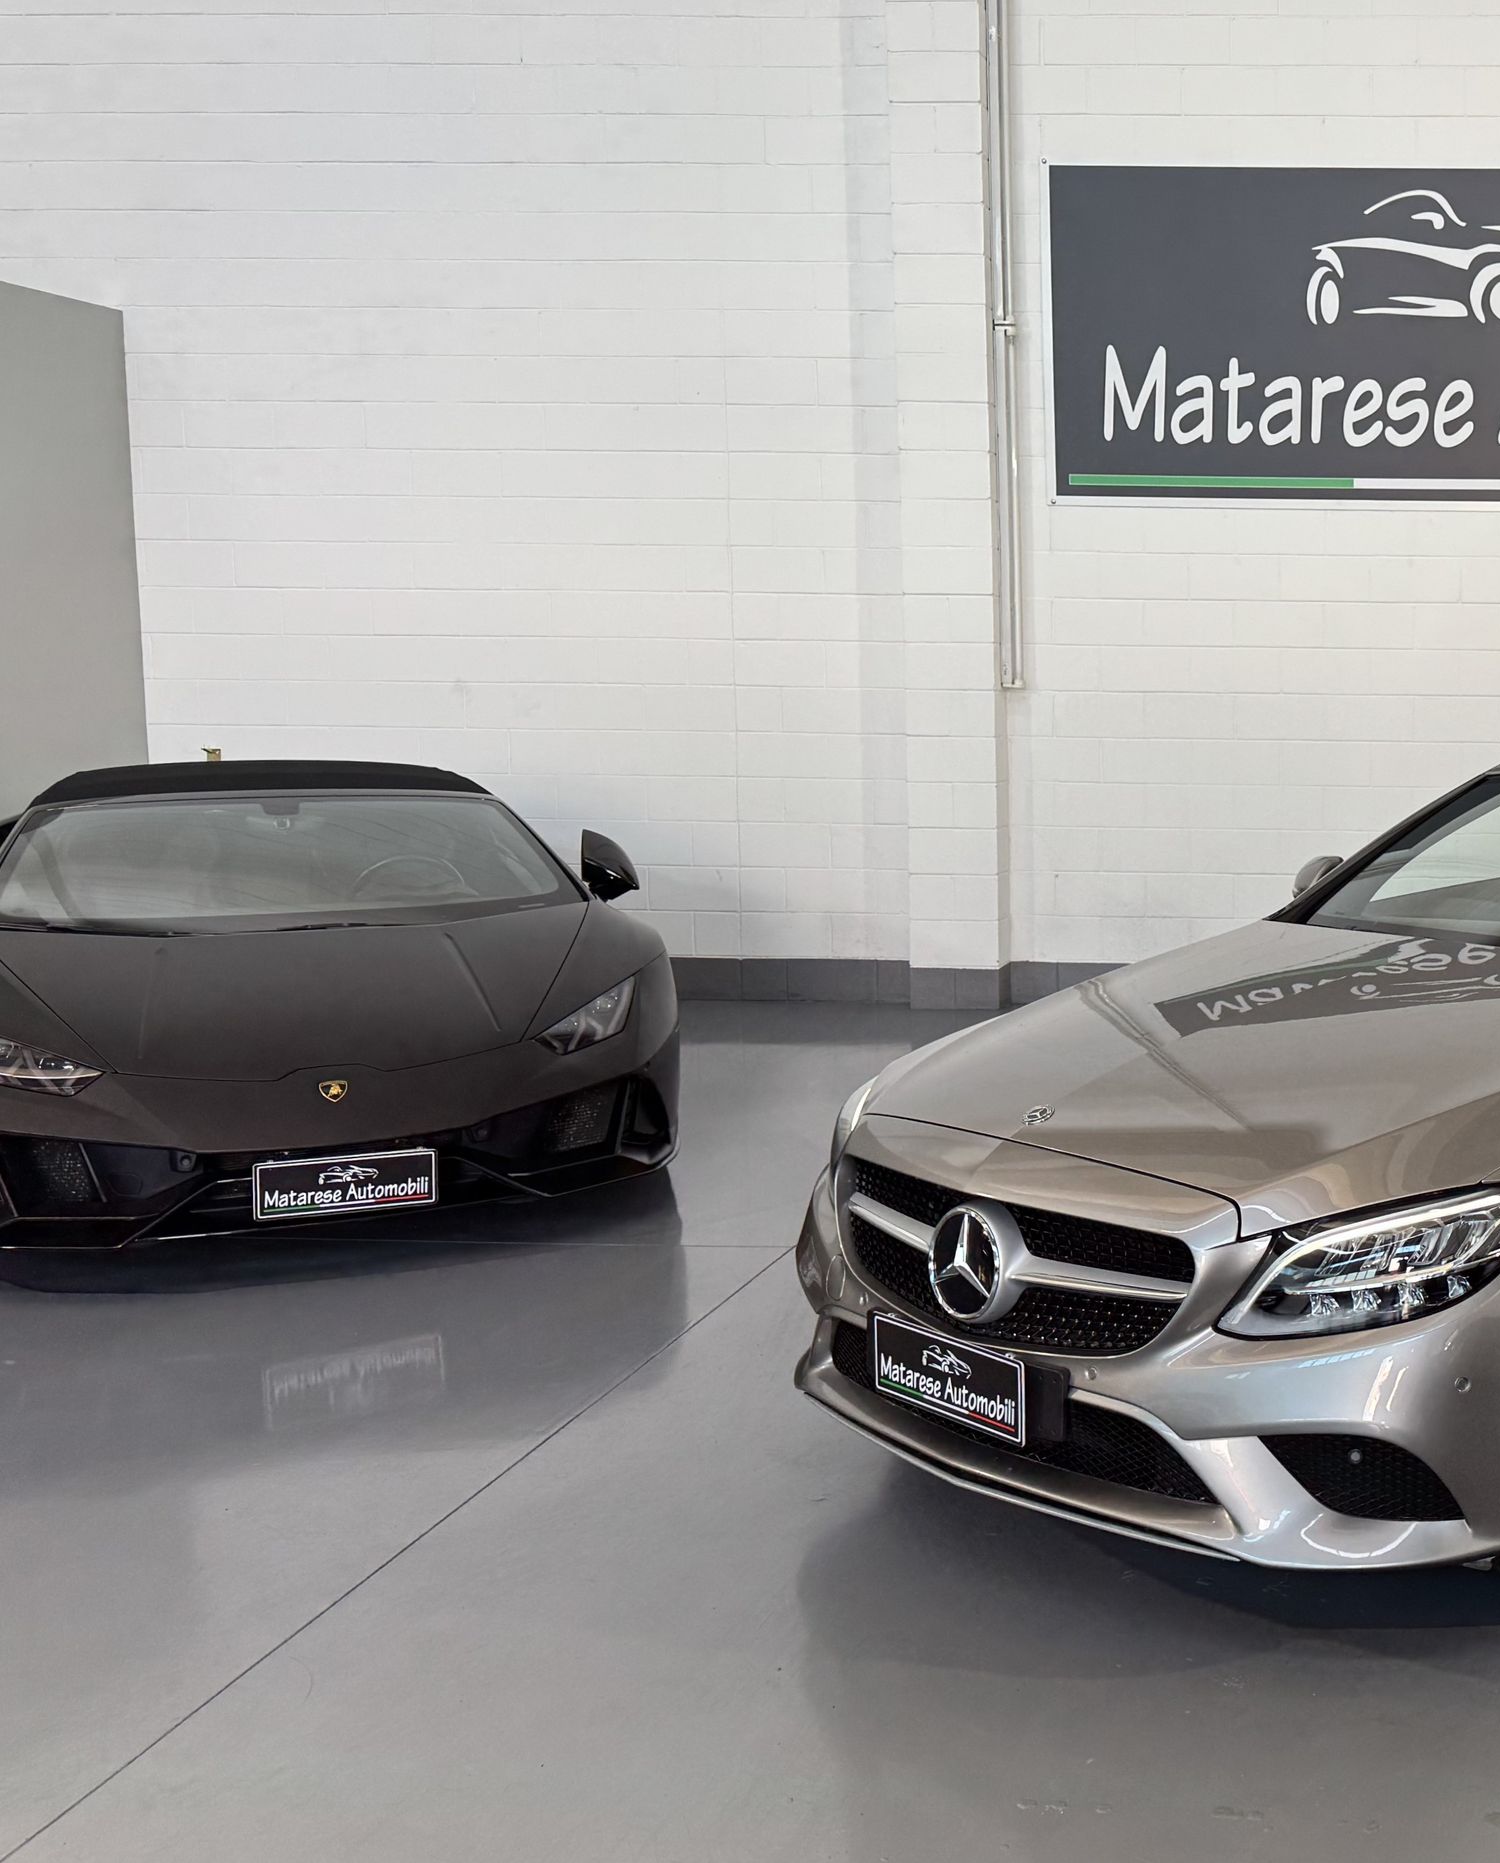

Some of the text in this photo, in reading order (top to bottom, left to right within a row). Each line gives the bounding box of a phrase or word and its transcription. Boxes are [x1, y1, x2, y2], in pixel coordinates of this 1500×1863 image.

[1103, 344, 1475, 448] Matarese
[263, 1176, 429, 1209] Matarese Automobili
[880, 1352, 1016, 1427] Matarese Automobili
